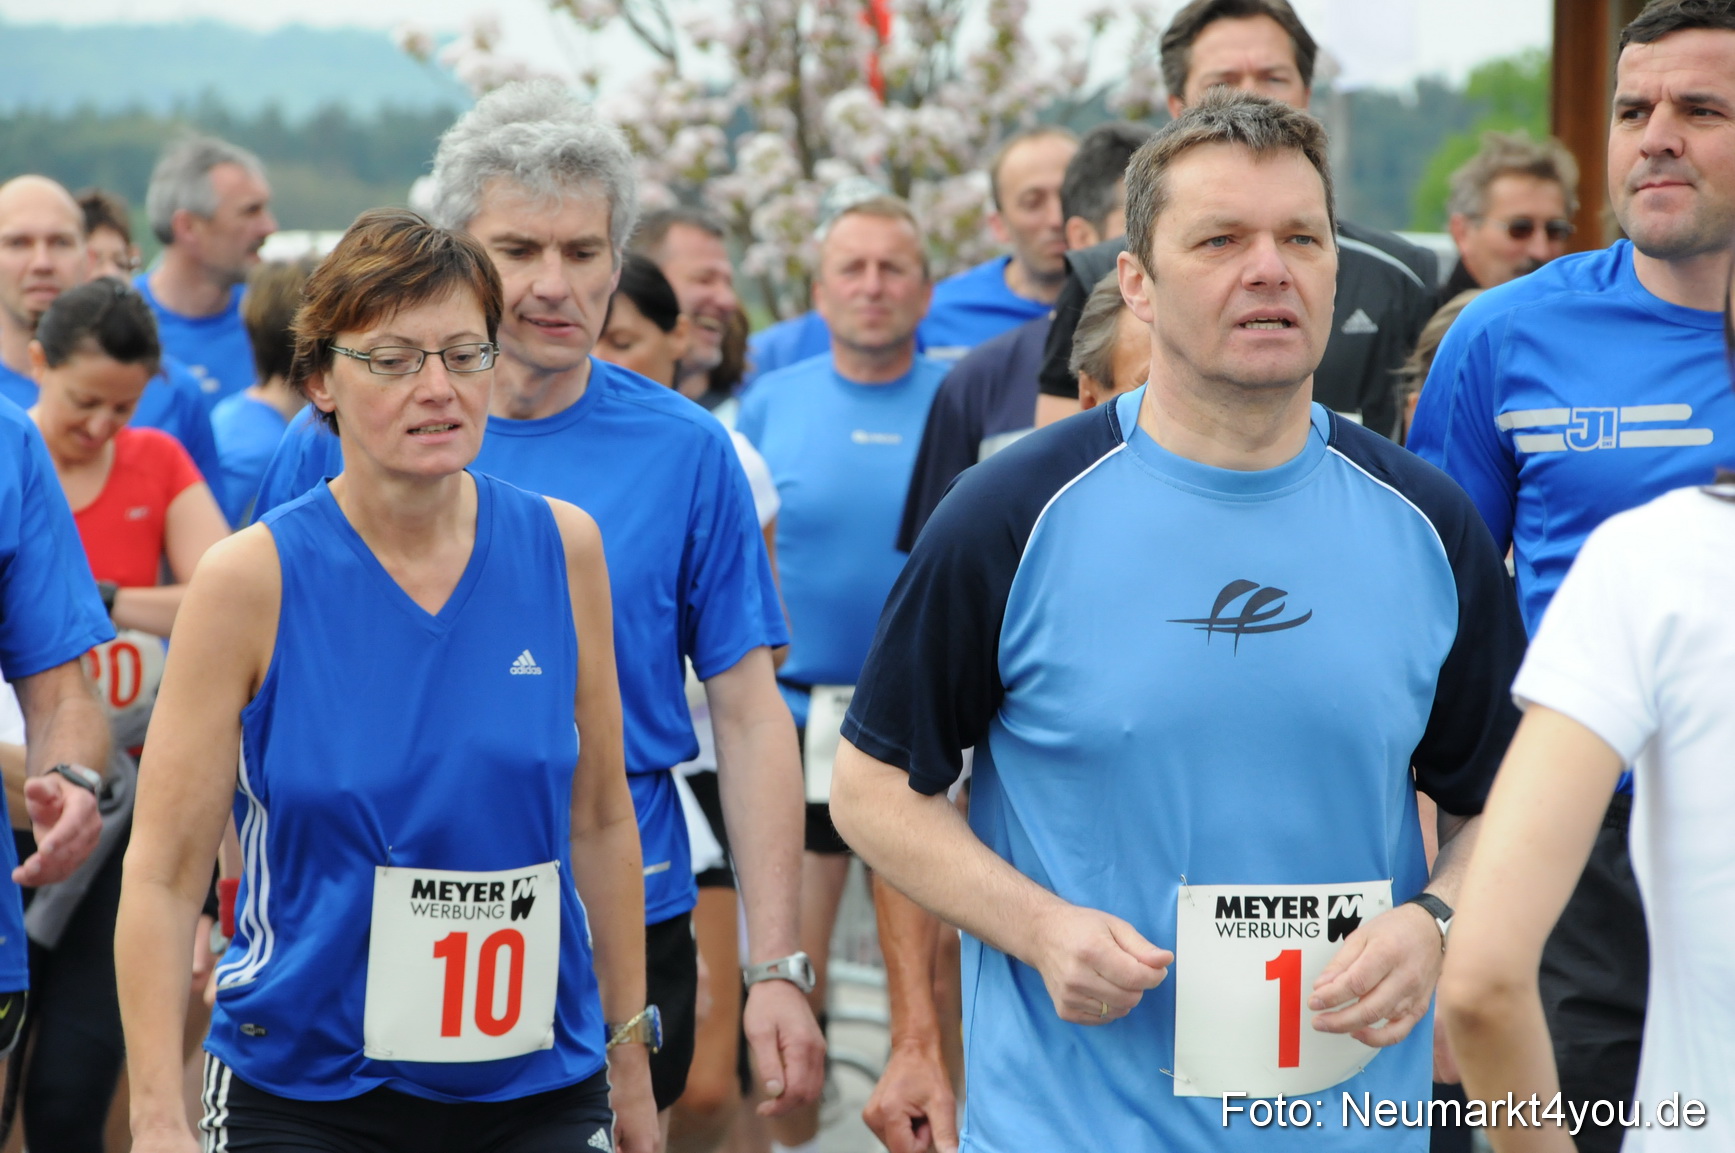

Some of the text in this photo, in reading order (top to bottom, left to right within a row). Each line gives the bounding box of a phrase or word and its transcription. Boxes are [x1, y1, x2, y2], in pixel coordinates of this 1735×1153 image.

[411, 879, 505, 902] MEYER
[410, 901, 505, 920] WERBUNG
[1215, 895, 1320, 919] MEYER
[1215, 921, 1320, 938] WERBUNG
[433, 928, 525, 1037] 10
[1265, 949, 1302, 1068] 1
